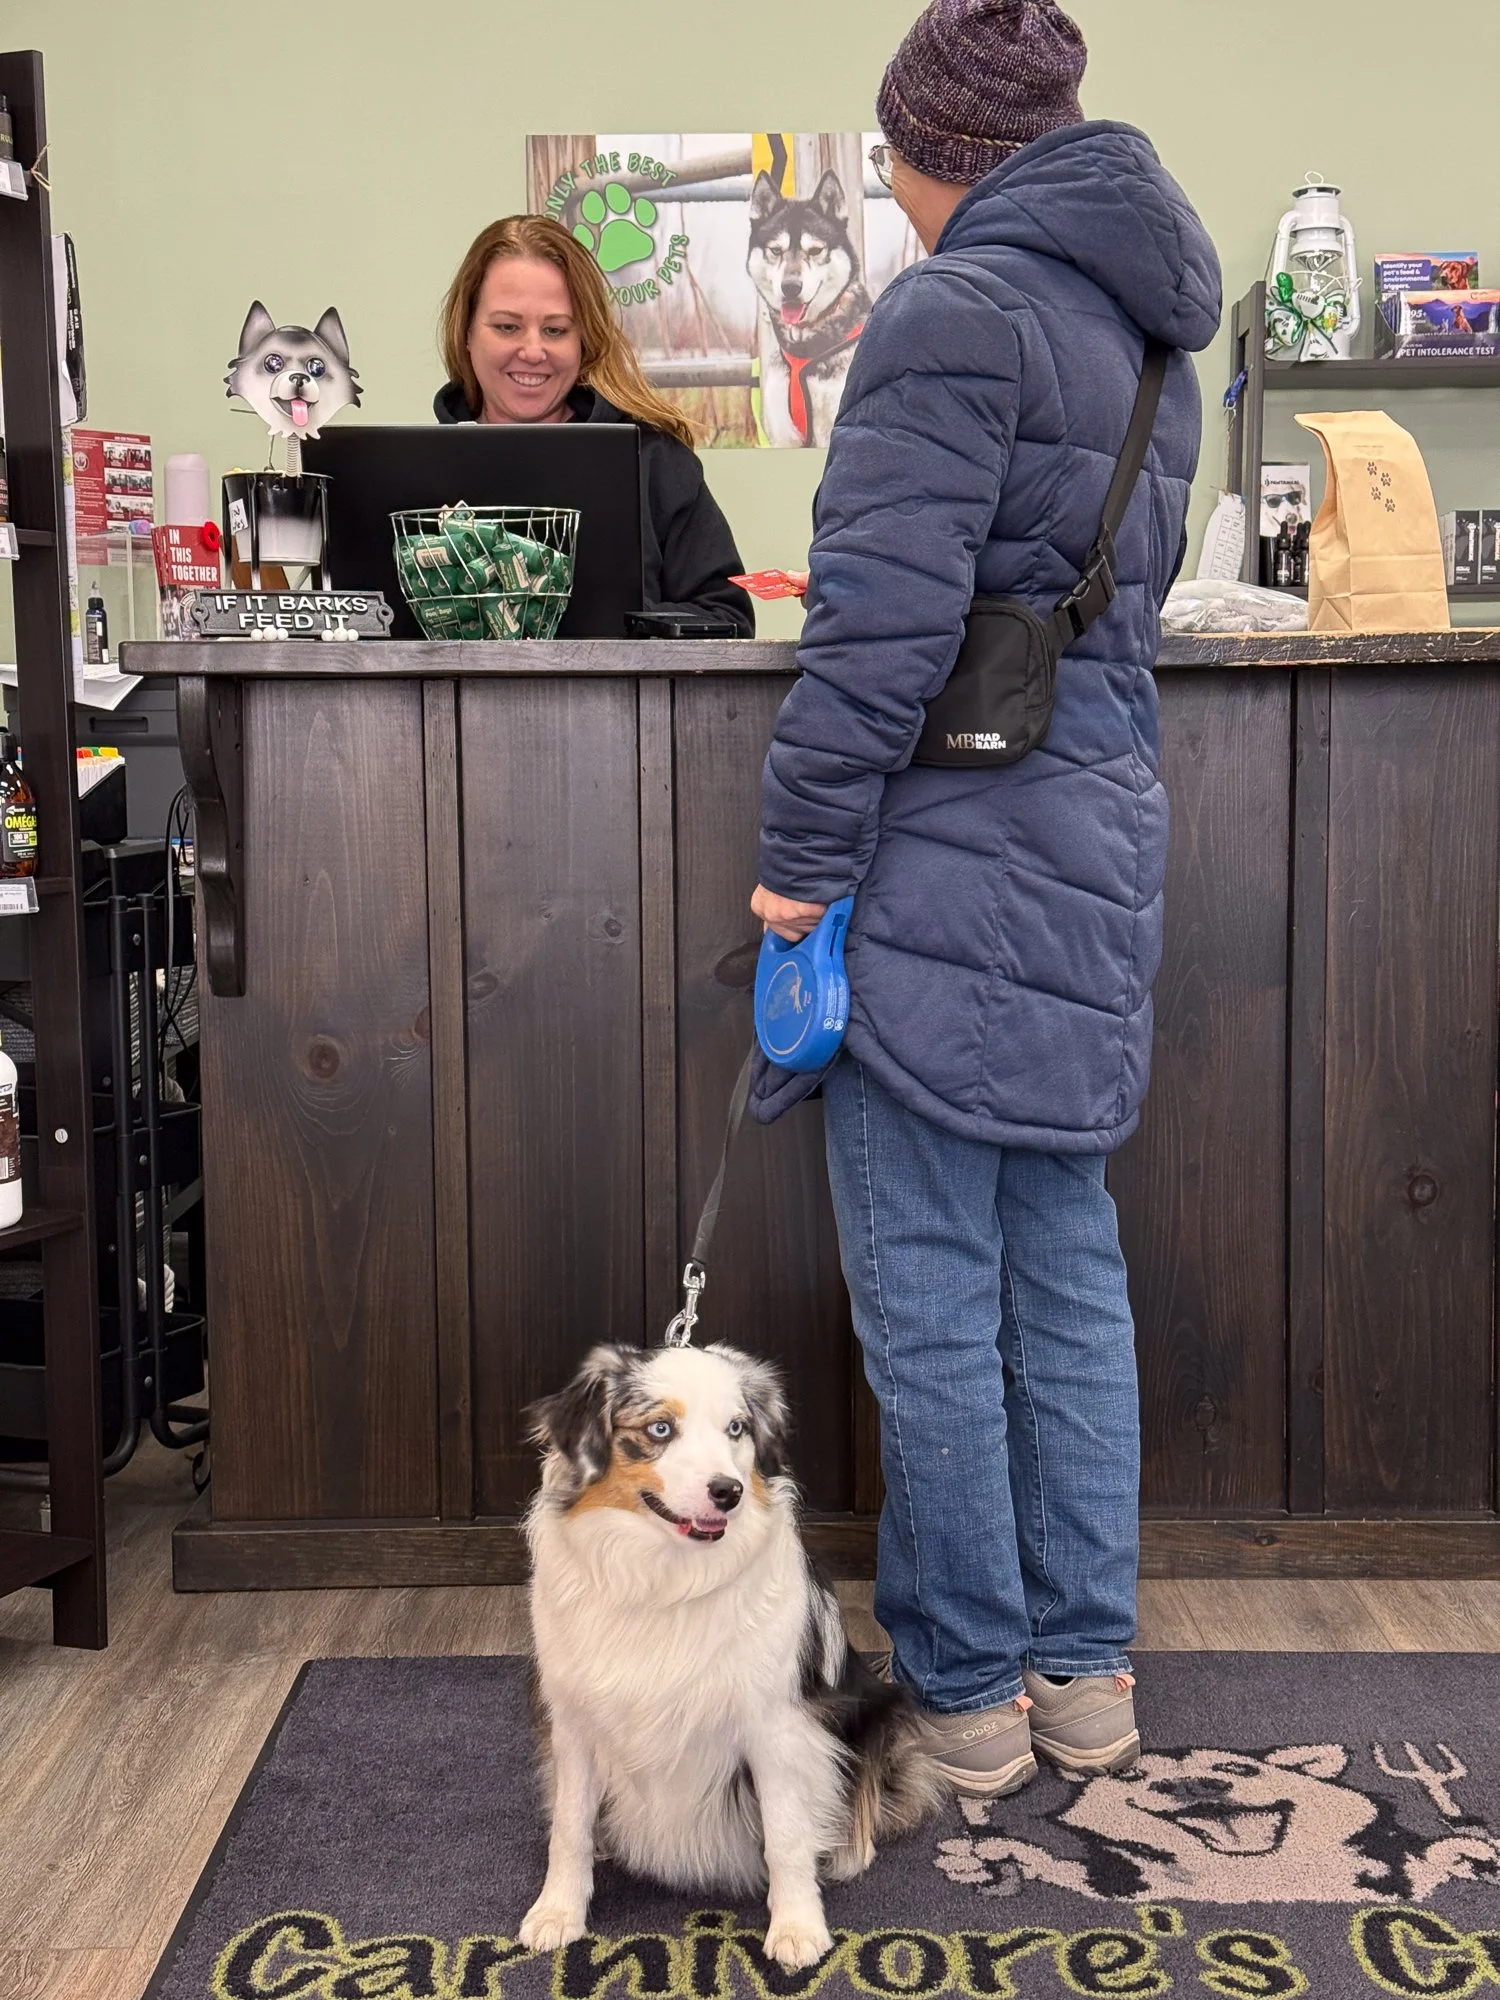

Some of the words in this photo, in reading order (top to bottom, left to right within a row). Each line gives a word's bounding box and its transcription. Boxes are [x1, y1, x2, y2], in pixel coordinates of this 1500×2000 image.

[544, 171, 577, 222] ONLY
[580, 152, 620, 178] THE
[627, 152, 677, 187] BEST
[656, 234, 690, 285] PETS
[1400, 348, 1416, 357] PET
[1417, 347, 1474, 356] INTOLERANCE
[1475, 346, 1496, 355] TEST
[168, 529, 180, 545] IN
[170, 547, 192, 564] THIS
[171, 566, 218, 582] TOGETHER
[215, 595, 237, 611] IF
[246, 595, 267, 611] IT
[279, 595, 368, 612] BARKS
[239, 613, 314, 629] FEED
[324, 614, 349, 630] IT
[946, 733, 975, 749] MB
[975, 733, 1000, 742] MAD
[976, 740, 1007, 749] BARN
[212, 1902, 1308, 2000] Carnivore's
